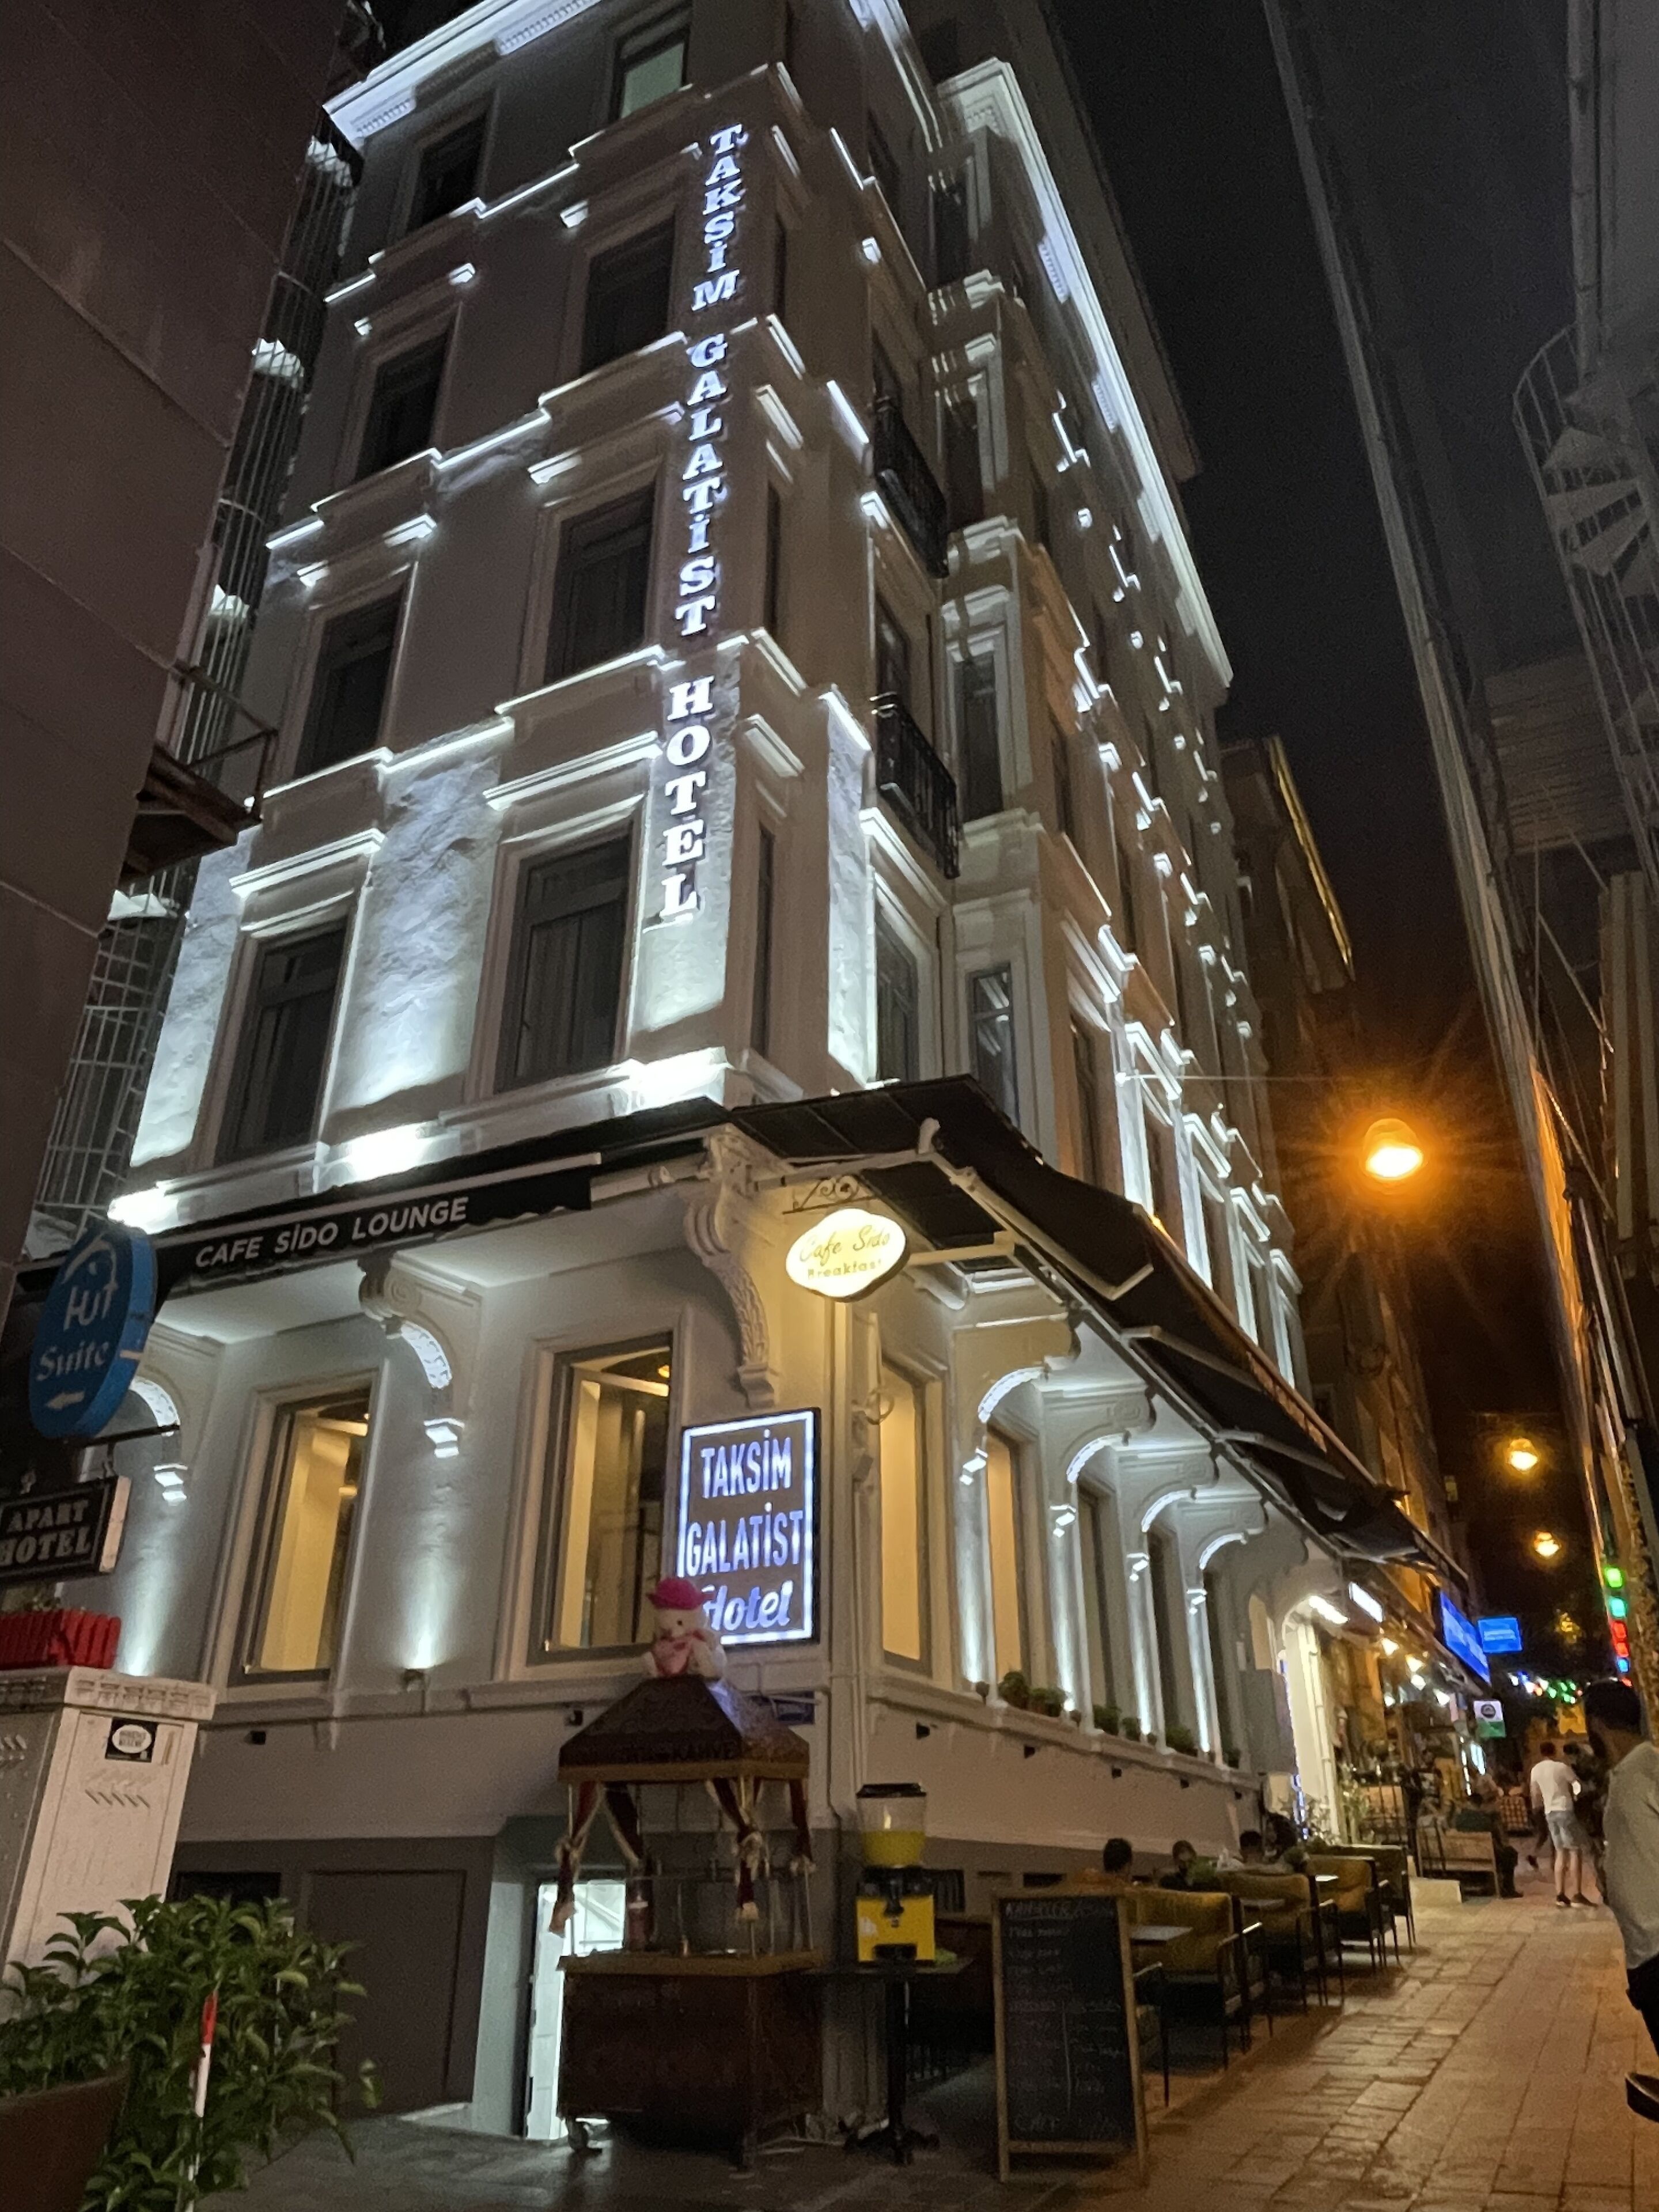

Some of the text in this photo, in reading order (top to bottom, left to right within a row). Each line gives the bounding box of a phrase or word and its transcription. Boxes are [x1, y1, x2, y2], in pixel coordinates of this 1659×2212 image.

[660, 676, 714, 916] HOTEL
[195, 1236, 263, 1267] CAFE
[351, 1196, 469, 1240] LOUNGE
